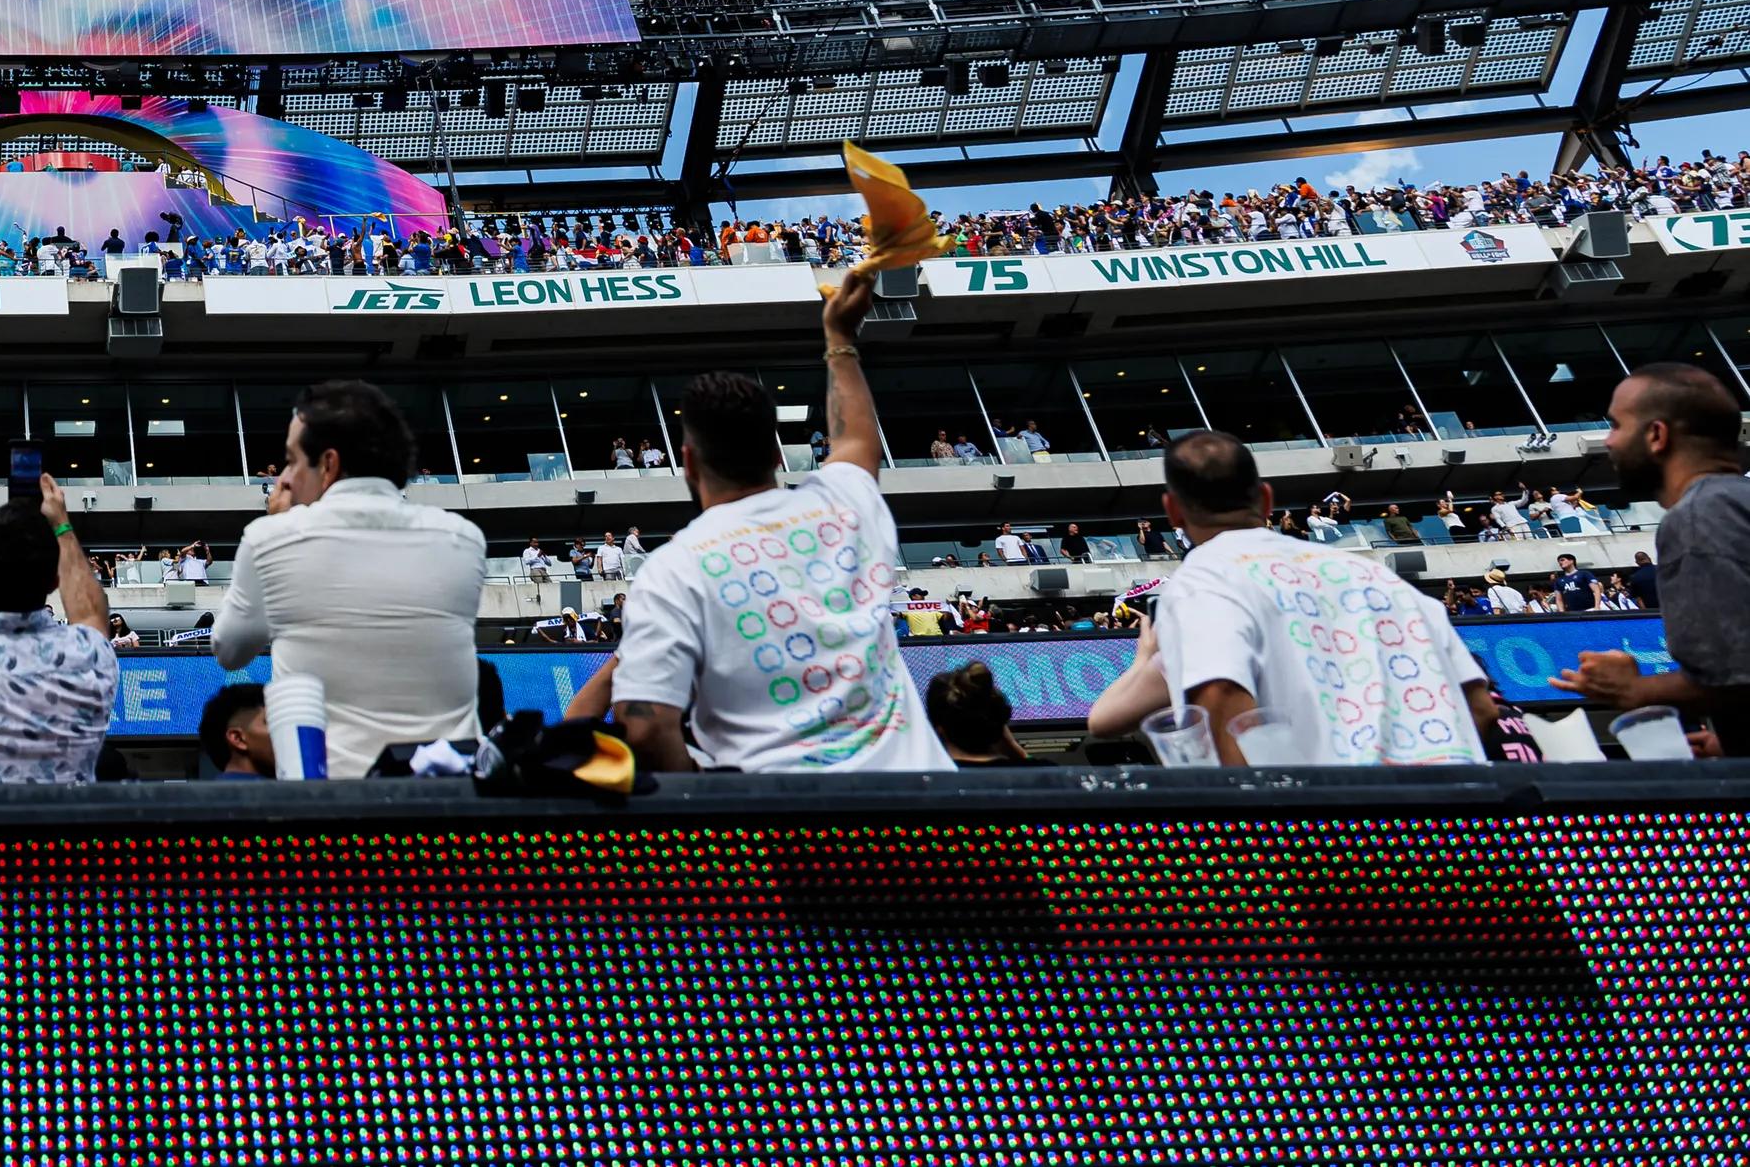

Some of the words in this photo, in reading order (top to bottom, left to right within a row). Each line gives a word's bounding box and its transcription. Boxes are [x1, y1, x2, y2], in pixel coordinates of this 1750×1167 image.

[955, 259, 1029, 292] 75
[1091, 247, 1295, 283] WINSTON
[1295, 242, 1387, 271] HILL
[333, 286, 445, 310] JETS
[469, 278, 574, 307] LEON
[581, 274, 682, 302] HESS
[907, 602, 942, 611] LOVE
